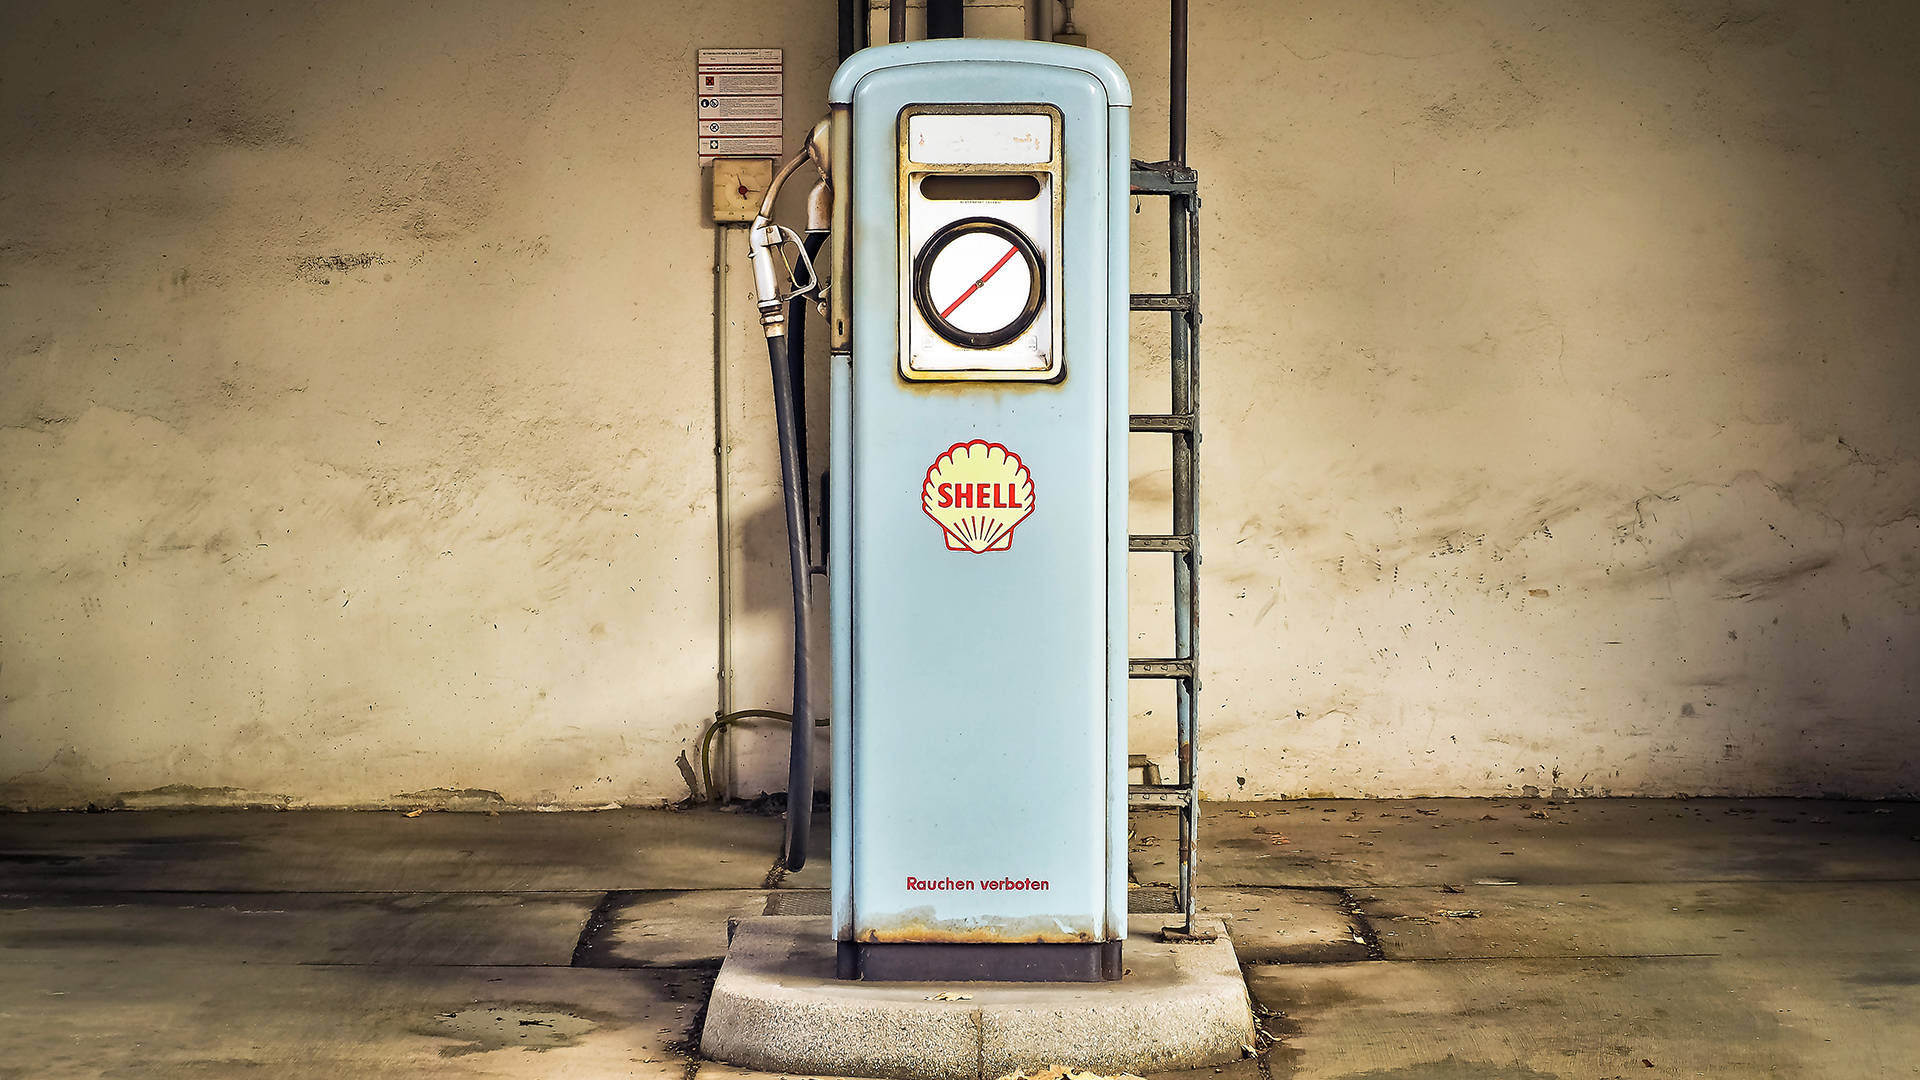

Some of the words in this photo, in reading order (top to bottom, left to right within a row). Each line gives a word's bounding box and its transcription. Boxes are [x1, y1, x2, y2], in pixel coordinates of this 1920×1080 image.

[938, 483, 1022, 508] SHELL
[906, 876, 975, 890] Rauchen
[980, 876, 1049, 890] verboten
